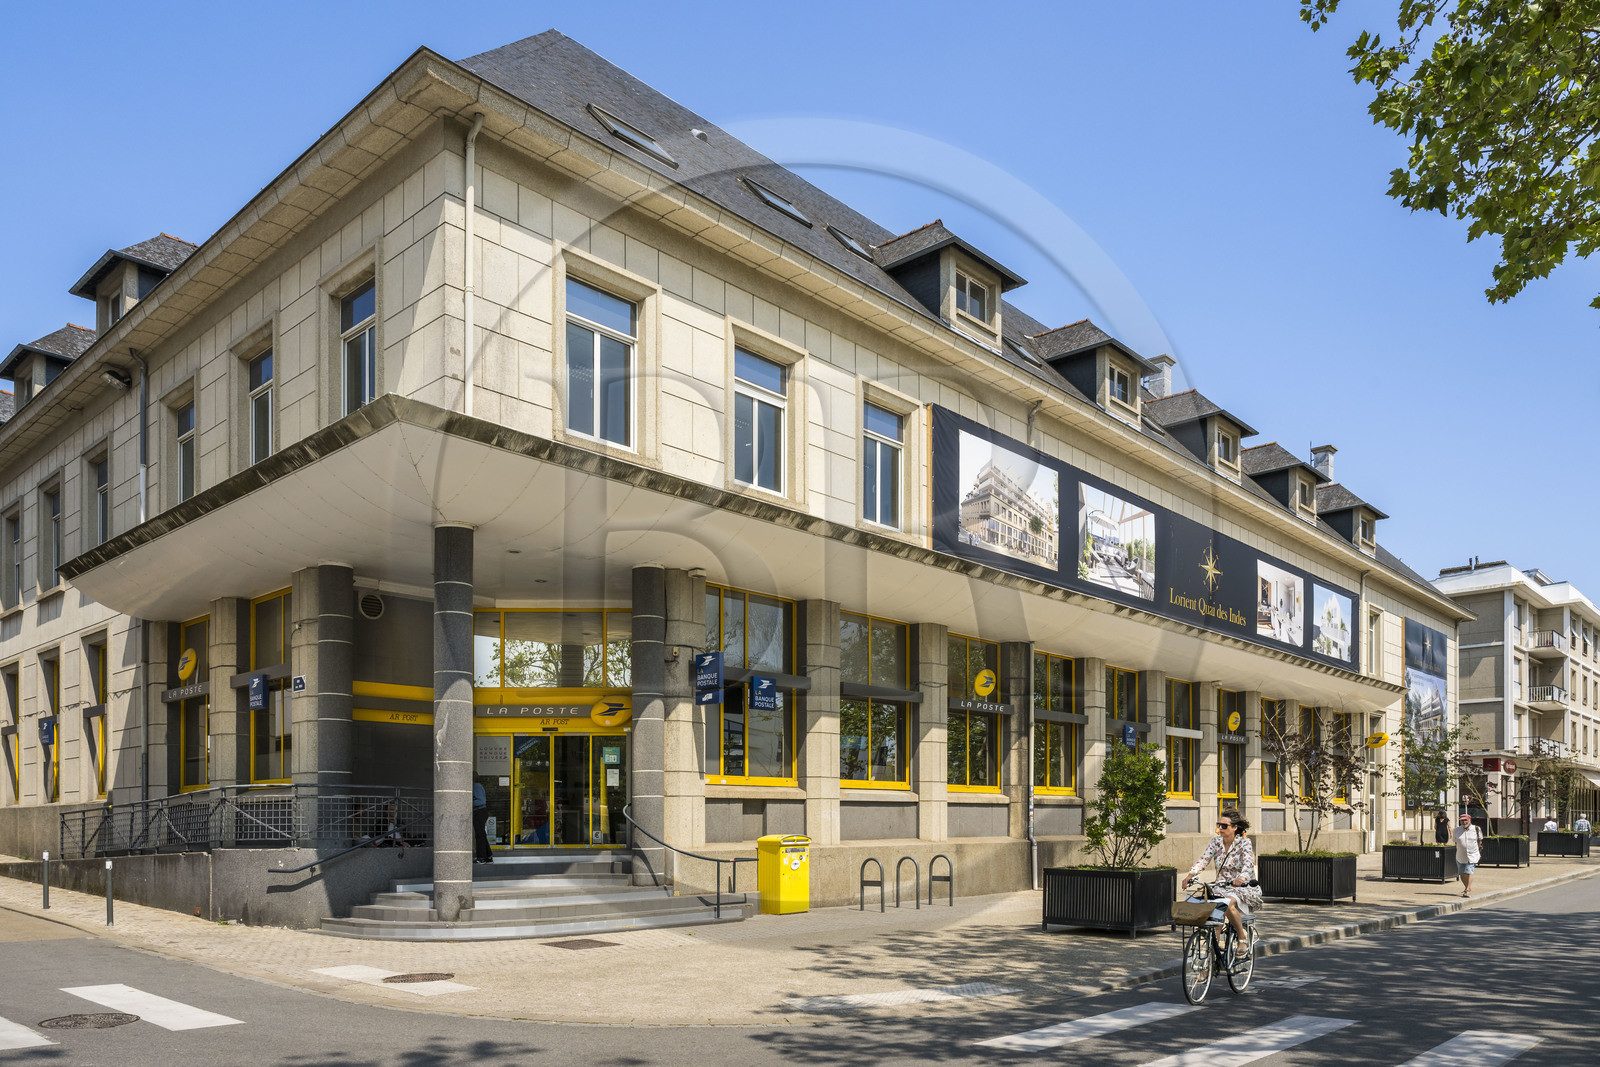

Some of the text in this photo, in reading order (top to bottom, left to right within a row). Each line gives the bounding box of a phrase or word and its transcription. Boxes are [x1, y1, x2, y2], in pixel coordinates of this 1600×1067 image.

[1170, 588, 1247, 626] Lorient Quai des Indes
[697, 673, 718, 681] BANQUE
[697, 679, 718, 687] POSTALE
[168, 685, 202, 699] LA POSTE
[486, 707, 579, 715] LA POSTE
[976, 702, 1004, 712] POSTE
[389, 713, 419, 722] AR POST
